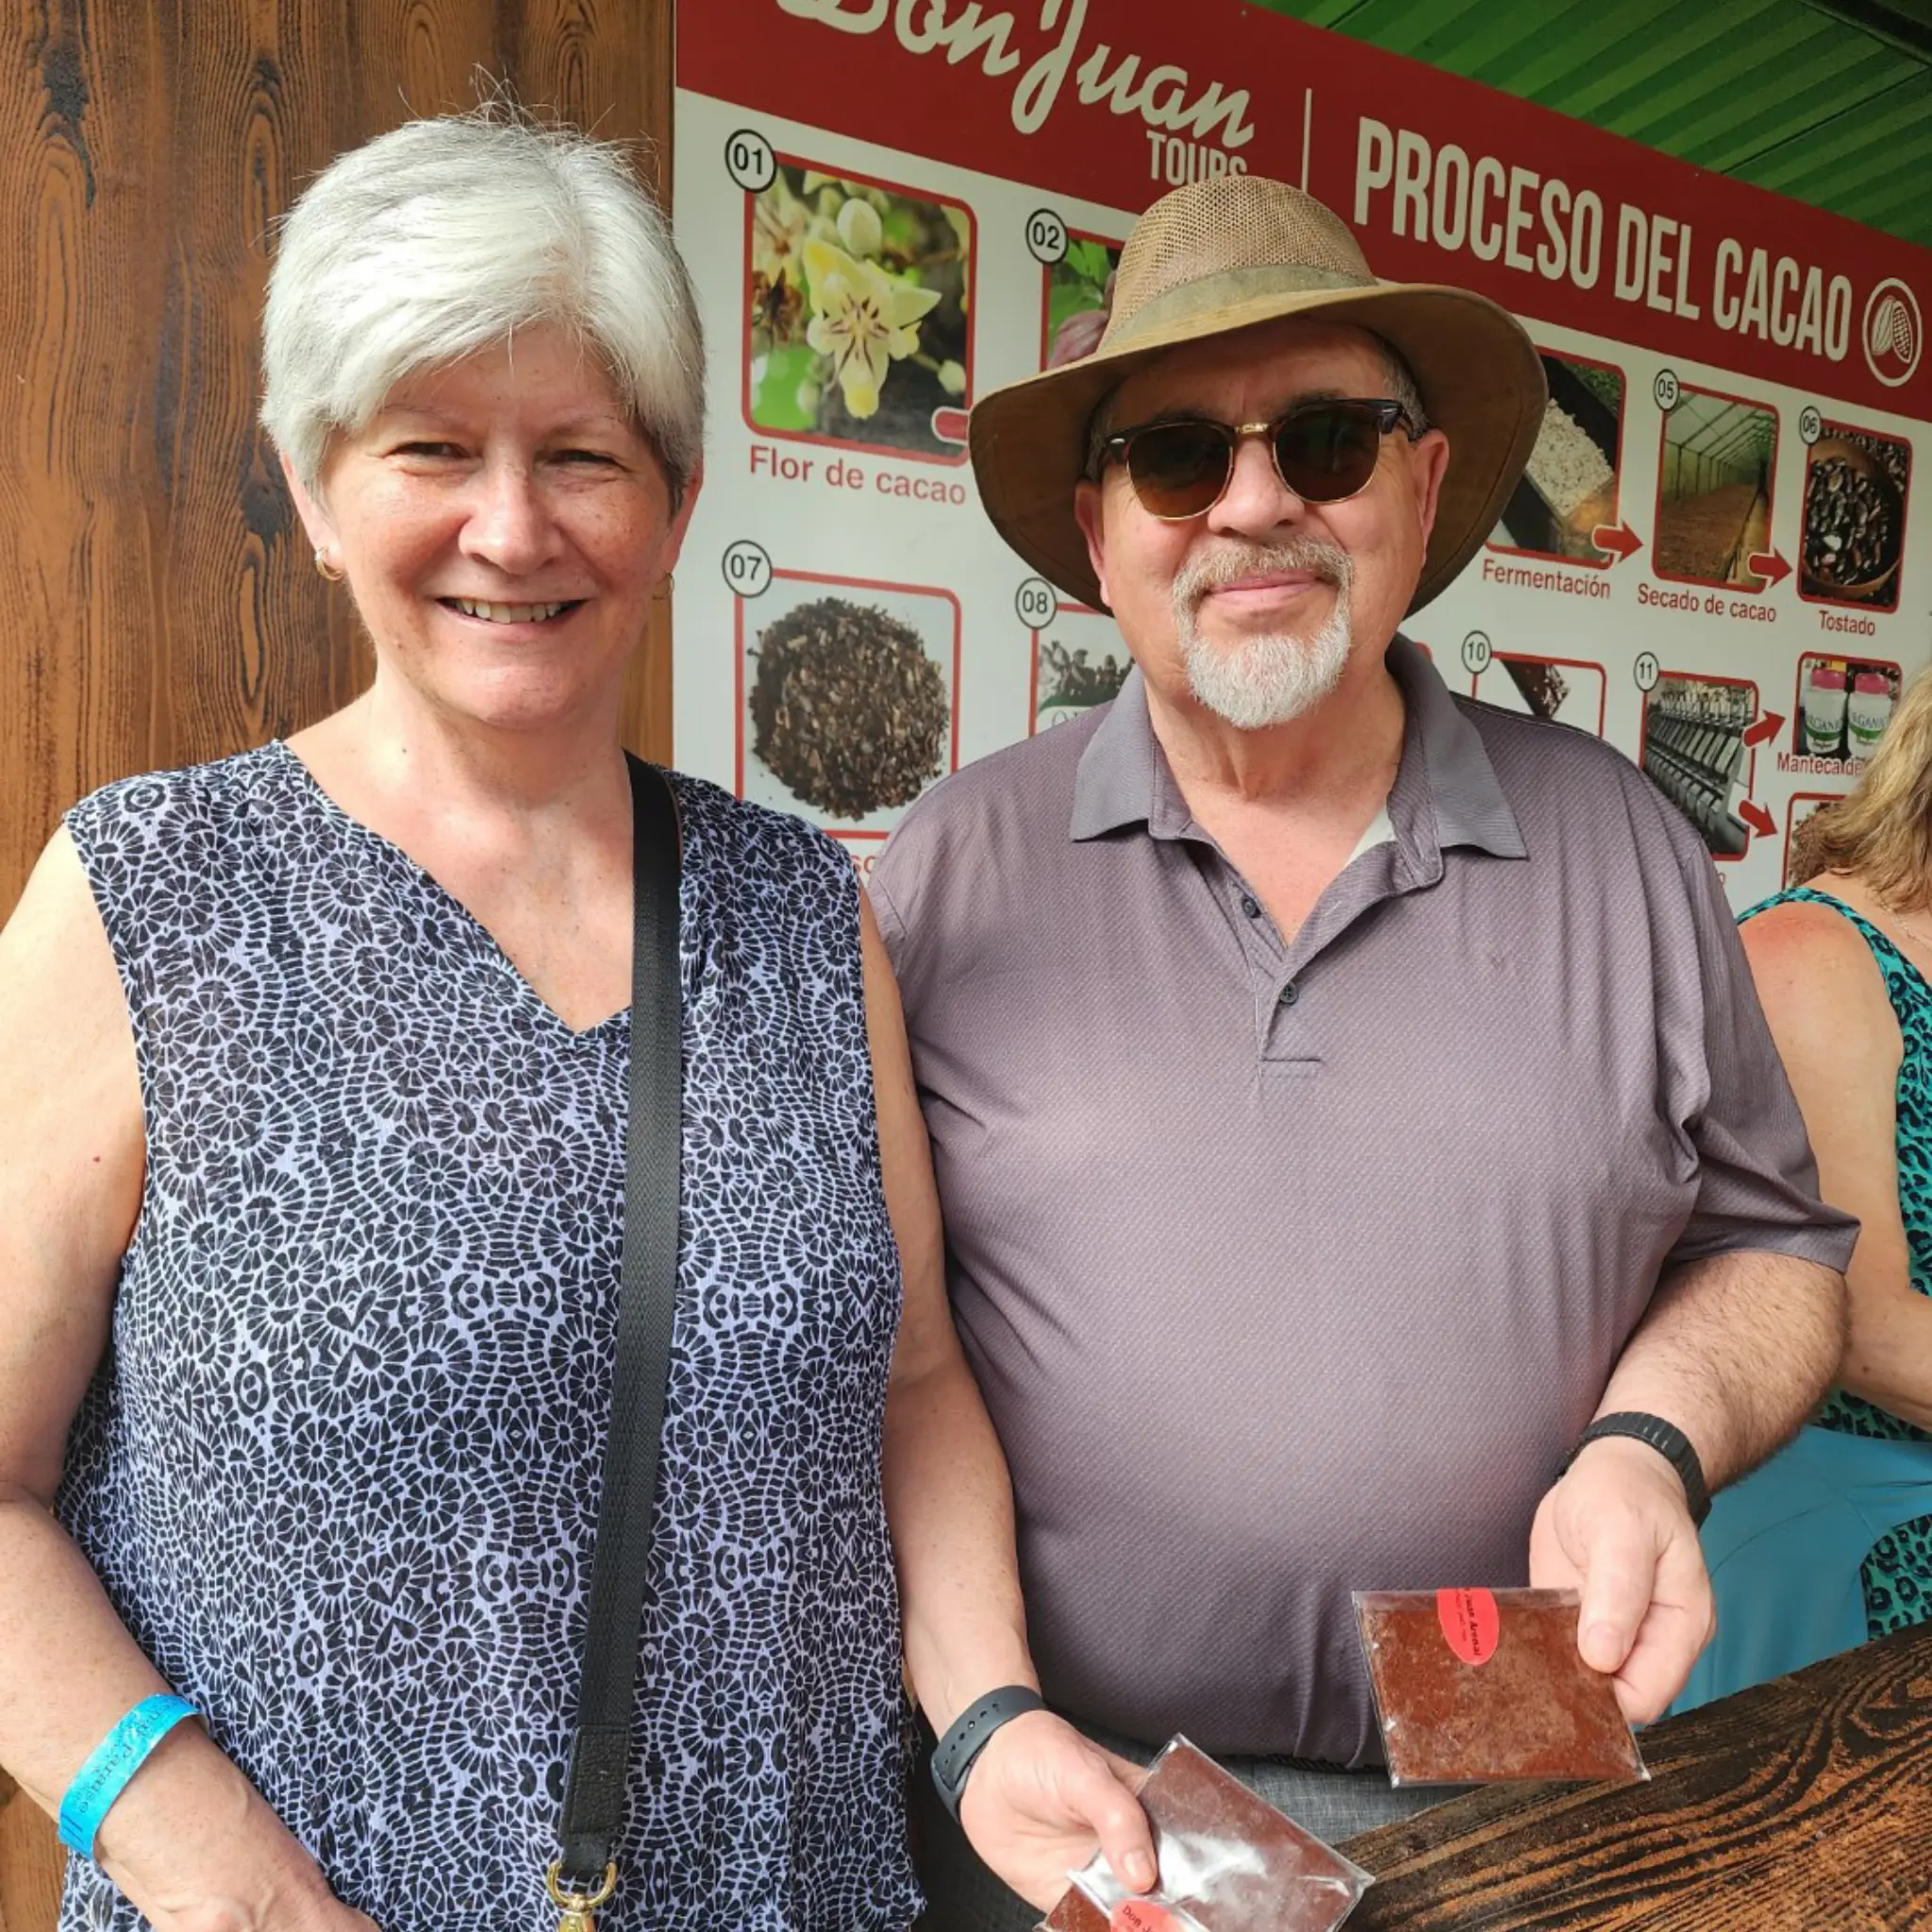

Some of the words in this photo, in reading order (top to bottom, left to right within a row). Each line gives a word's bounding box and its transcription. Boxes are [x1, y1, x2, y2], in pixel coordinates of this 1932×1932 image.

[1011, 0, 1255, 148] Juan
[733, 142, 763, 175] 01
[1032, 222, 1060, 250] 02
[1354, 116, 1603, 289] PROCESO
[1614, 203, 1700, 320] DEL
[1713, 238, 1852, 361] CACAO
[1657, 379, 1674, 400] 05
[1802, 415, 1819, 434] 06
[750, 444, 814, 482] Flor
[825, 458, 864, 491] de
[875, 471, 966, 506] cacao
[730, 554, 762, 581] 07
[1482, 558, 1611, 600] Fermentación
[1023, 589, 1048, 614] 08
[1638, 583, 1699, 612] Secado
[1704, 594, 1724, 615] de
[1729, 605, 1777, 624] cacao
[1818, 610, 1876, 637] Tostado
[1467, 641, 1486, 661] 10
[1639, 661, 1654, 680] 11
[1777, 752, 1844, 774] Manteca
